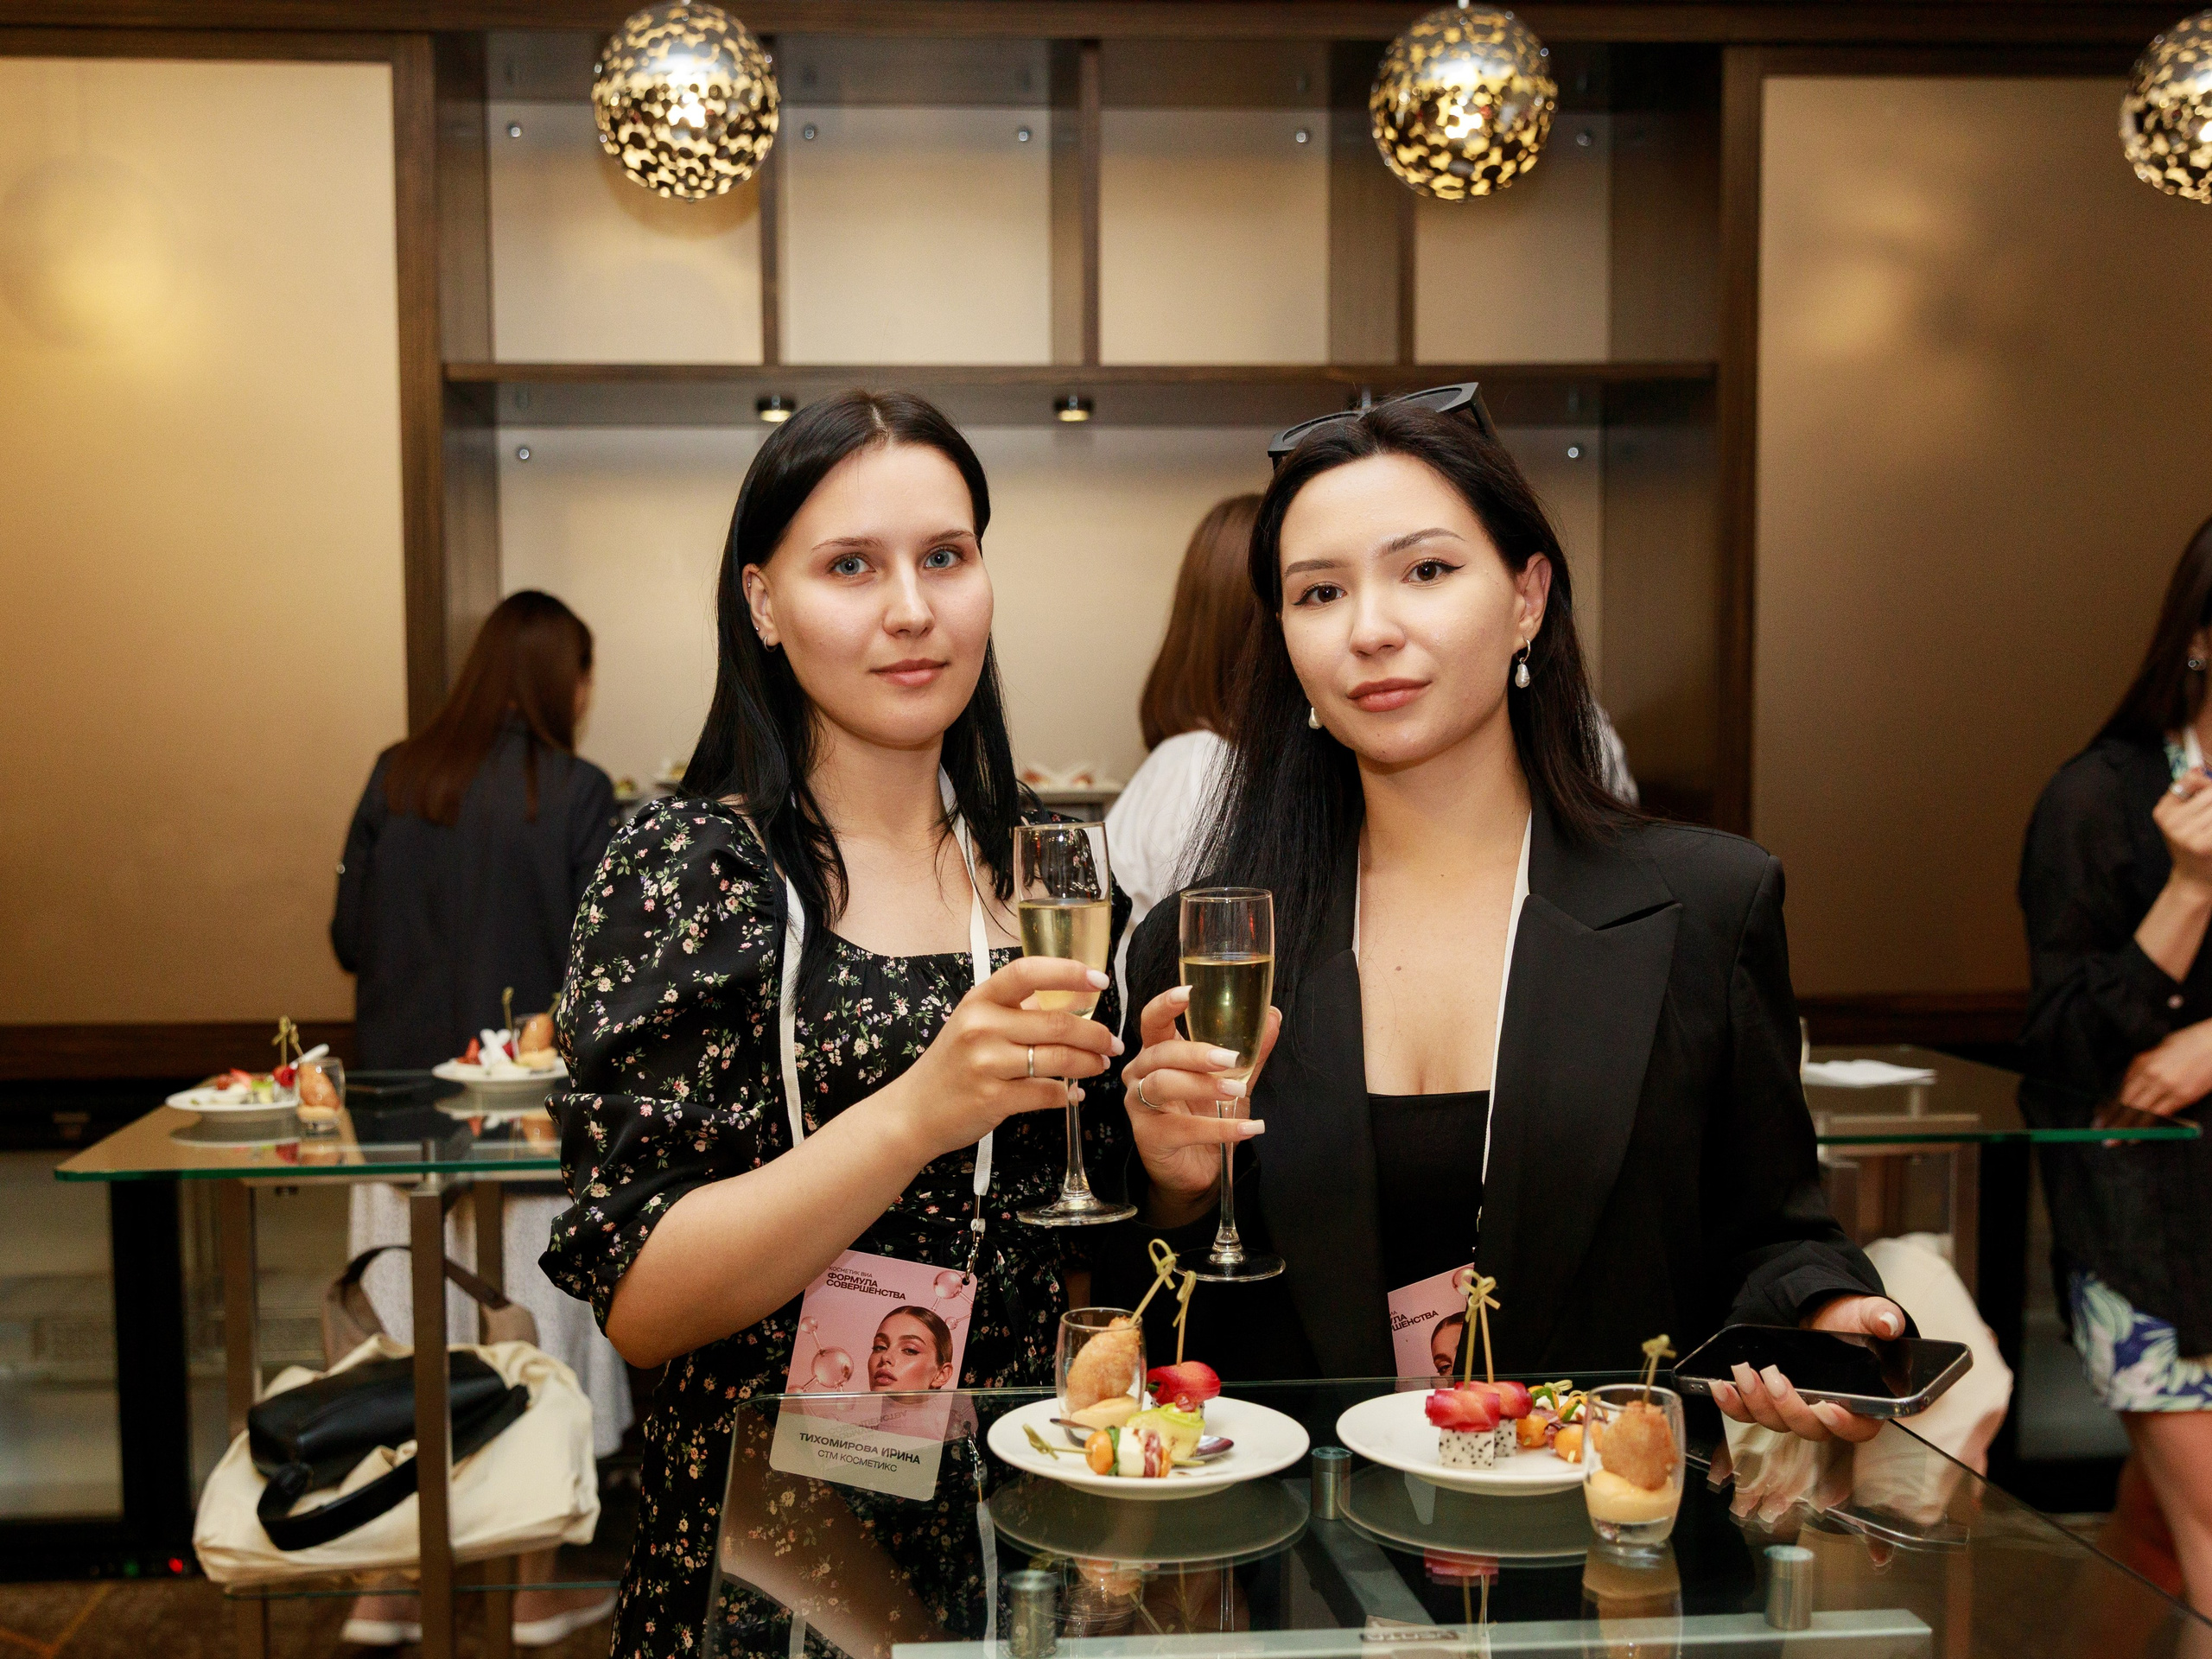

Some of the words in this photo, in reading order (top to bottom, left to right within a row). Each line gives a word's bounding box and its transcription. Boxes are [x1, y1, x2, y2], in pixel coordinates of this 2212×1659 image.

[826, 1279, 906, 1300] СОВЕРШЕНСТВА
[827, 1272, 878, 1287] ФОРМУЛА
[799, 1432, 878, 1454] ТИХОМИРОВА
[880, 1447, 921, 1465] ИРИНА
[817, 1449, 838, 1460] СТМ
[840, 1453, 898, 1472] КОСМЕТИКС
